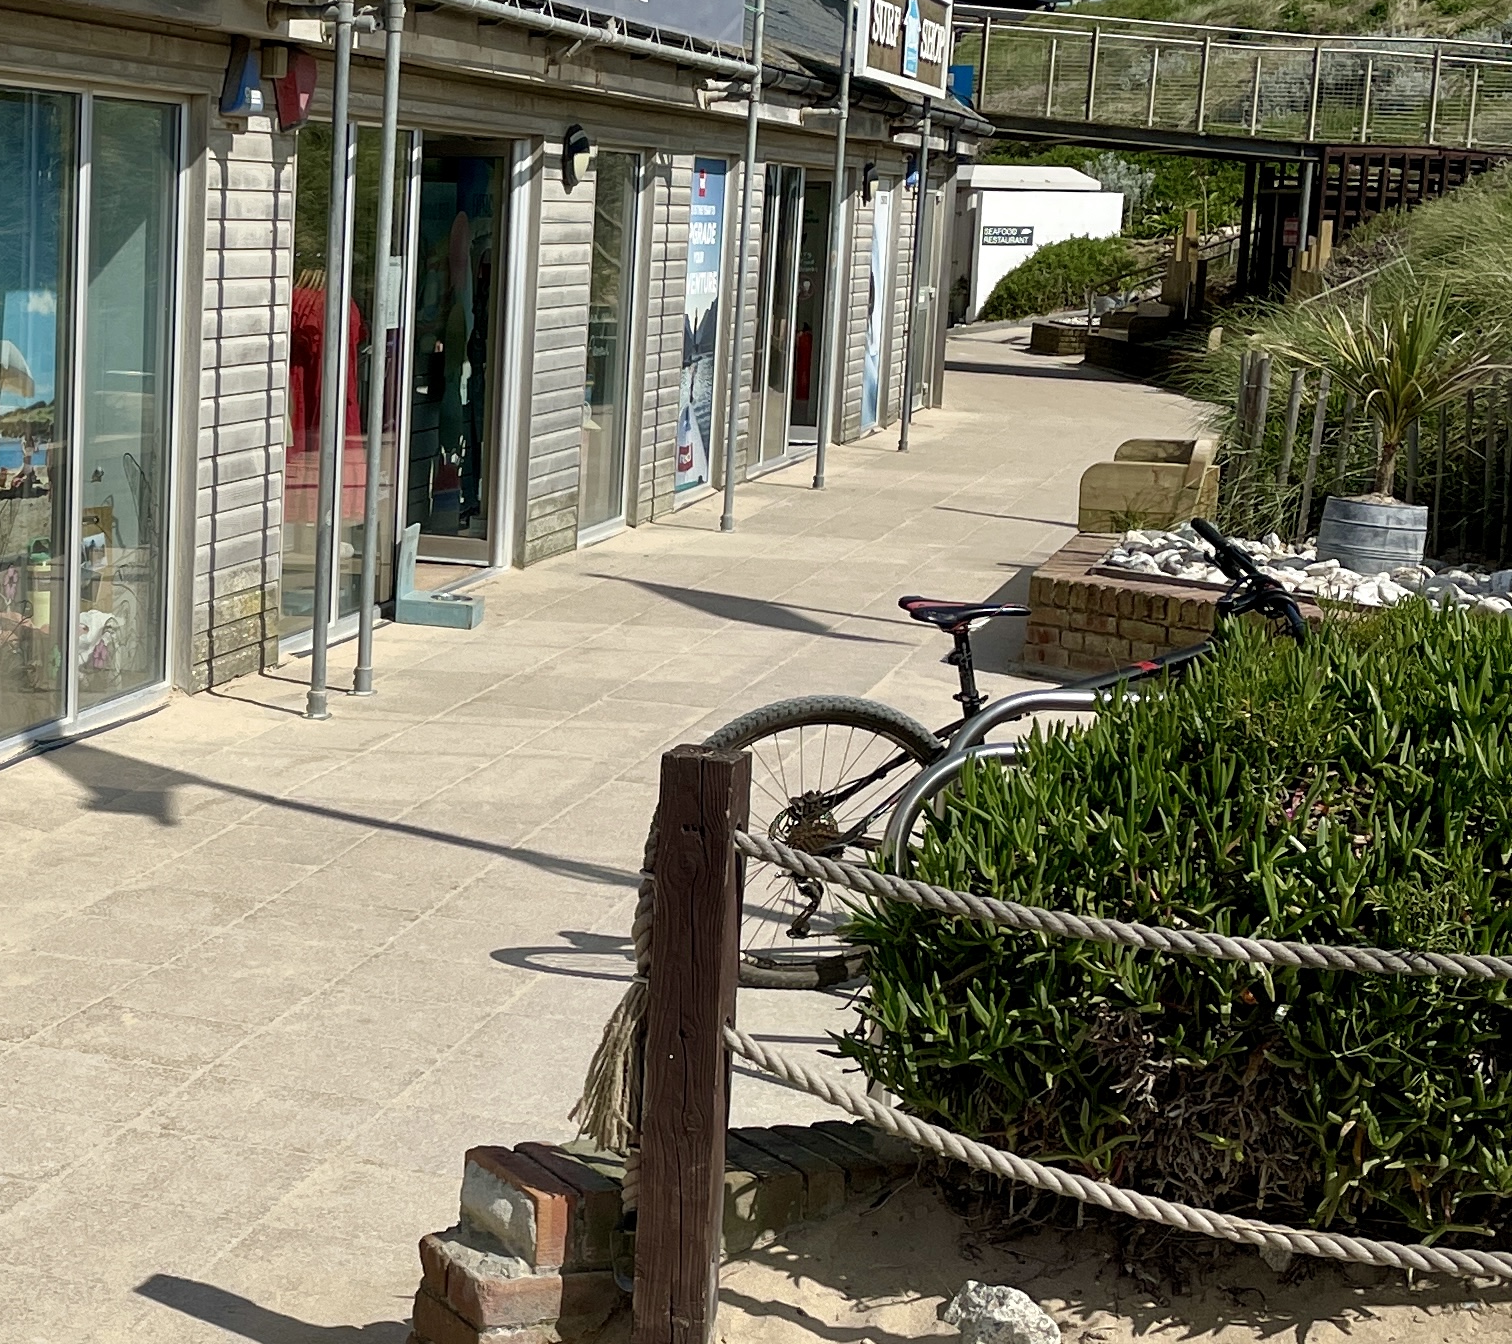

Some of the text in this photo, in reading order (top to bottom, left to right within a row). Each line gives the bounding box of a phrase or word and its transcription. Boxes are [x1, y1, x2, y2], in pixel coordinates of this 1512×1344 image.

[920, 18, 945, 64] SHOP
[984, 227, 1029, 244] SEAFOOD RESTAURANT
